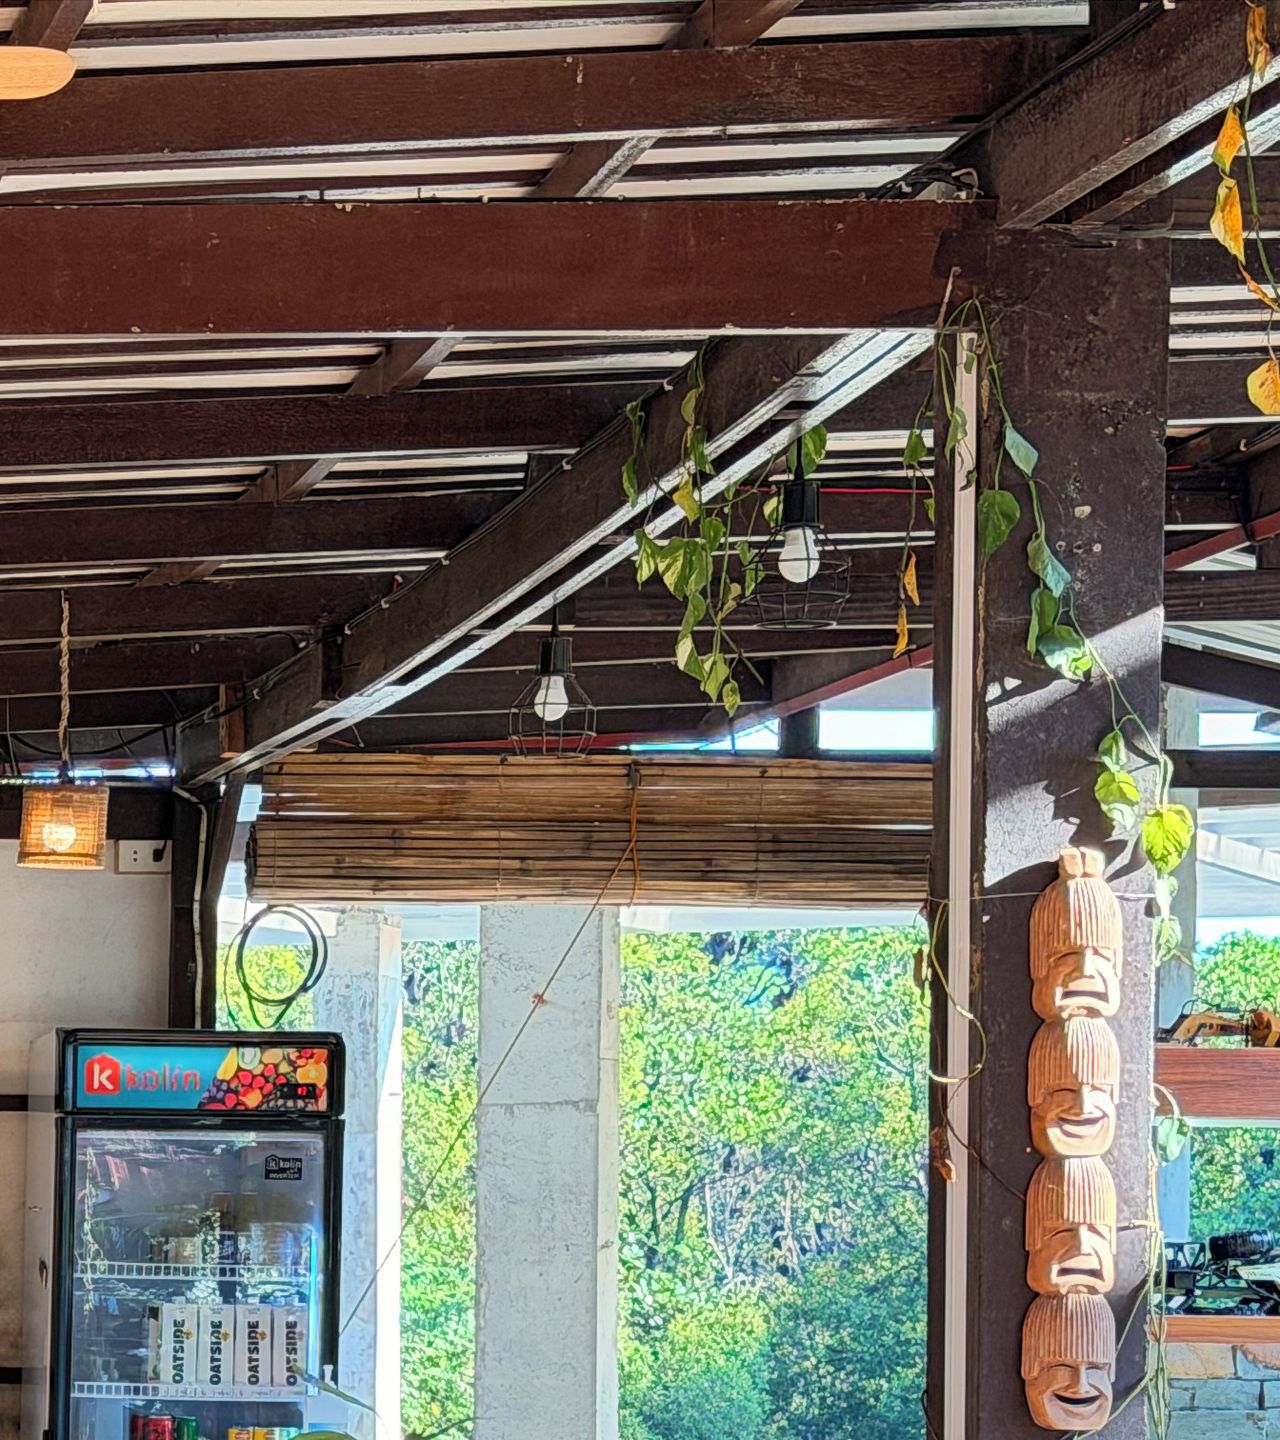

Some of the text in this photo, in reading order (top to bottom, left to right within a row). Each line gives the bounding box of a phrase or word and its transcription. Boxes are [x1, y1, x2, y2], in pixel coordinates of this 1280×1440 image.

[126, 1063, 200, 1091] kolin
[279, 1159, 301, 1168] kolin
[171, 1318, 186, 1385] OATSIDE
[209, 1320, 223, 1386] OATSIDE
[247, 1320, 260, 1386] OATSIDE
